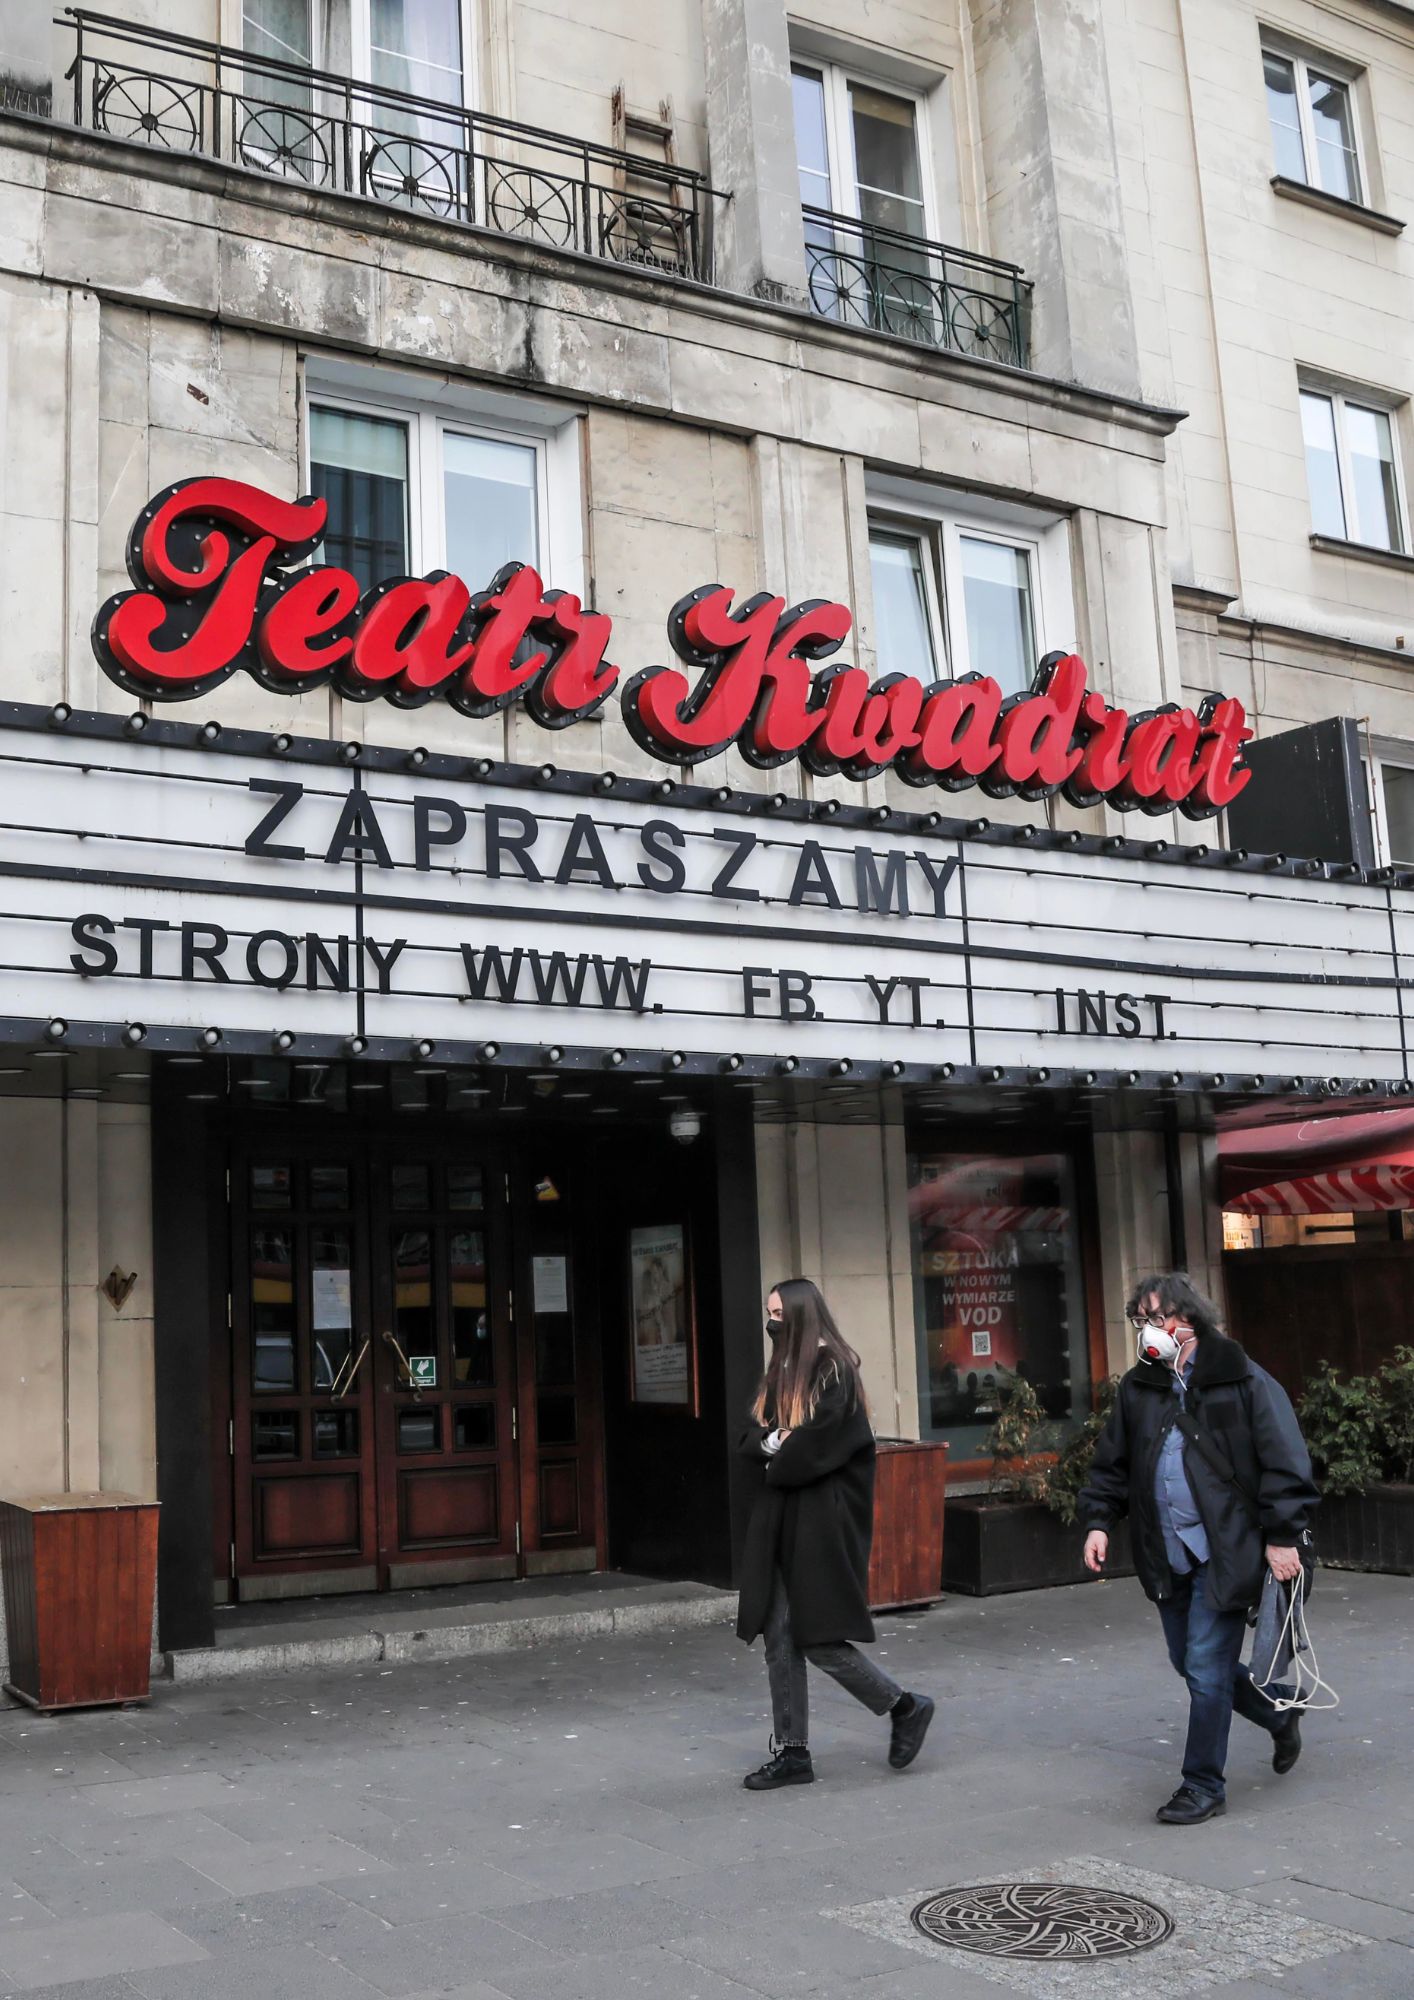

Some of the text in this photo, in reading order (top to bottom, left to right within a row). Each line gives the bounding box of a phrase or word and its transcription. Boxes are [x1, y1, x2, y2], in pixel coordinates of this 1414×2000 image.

[92, 477, 1253, 821] Teatr Kwadrat
[245, 777, 960, 920] ZAPRASZAMY
[70, 913, 1178, 1041] STRONY WWW. FB. YT. INST.
[932, 1251, 1019, 1271] SZTUKA
[943, 1273, 1012, 1288] W NOWYM
[942, 1290, 1016, 1305] WYMIARZE
[959, 1306, 1002, 1326] VOD
